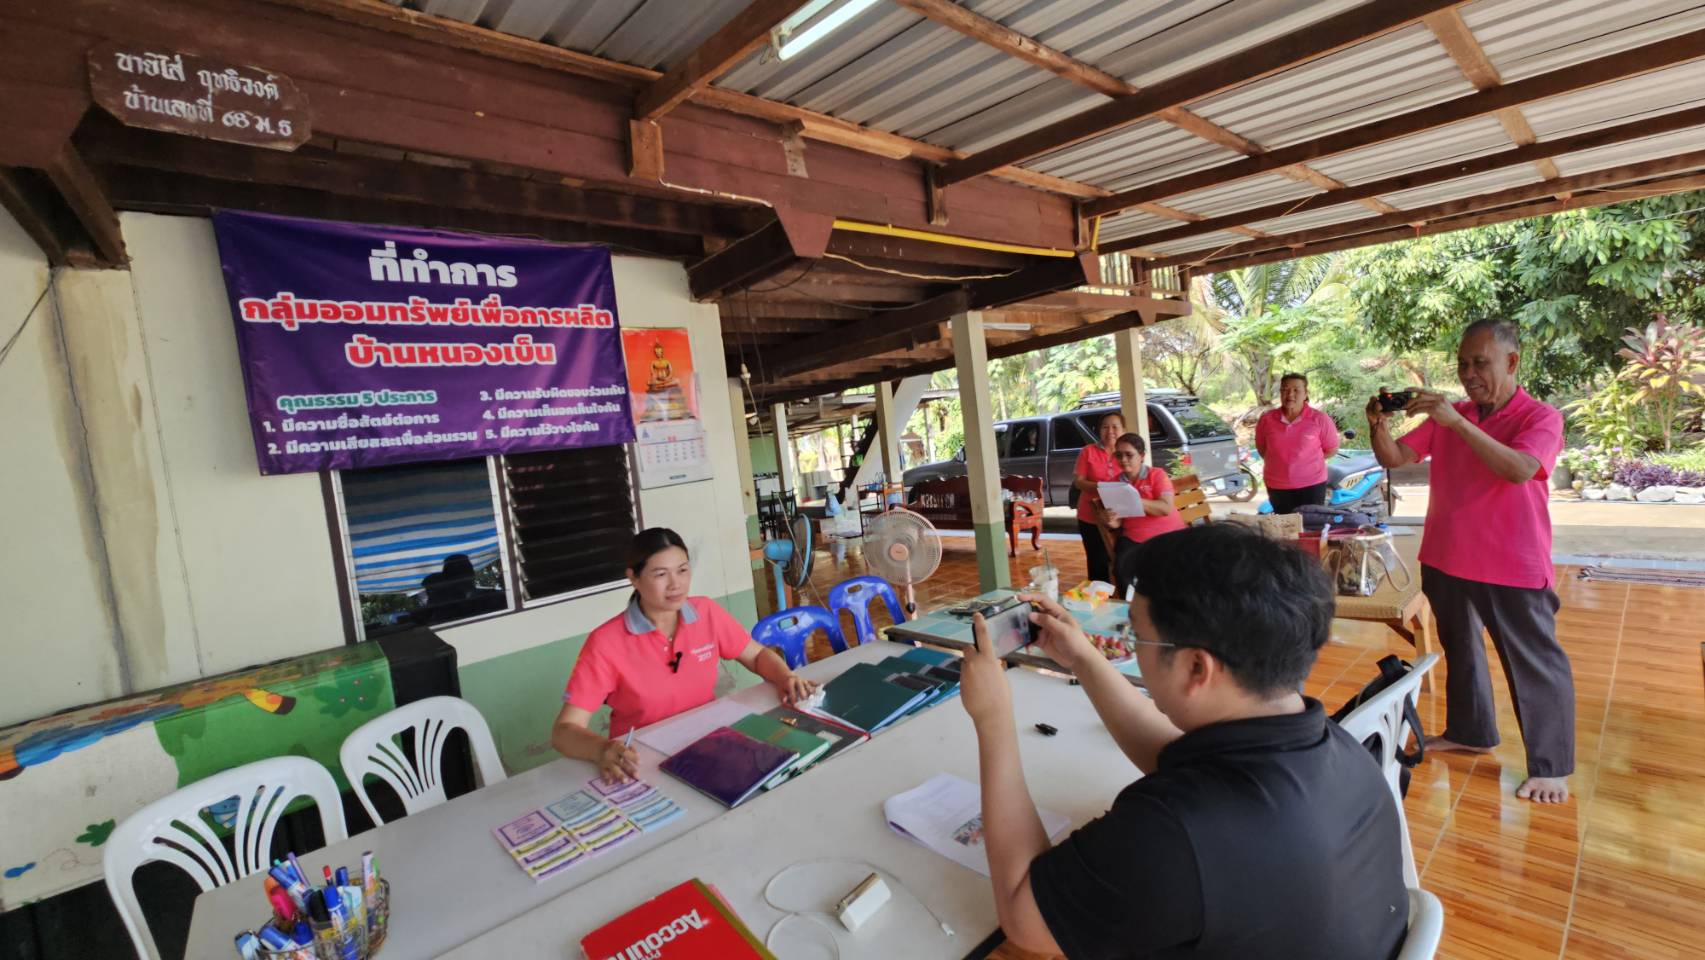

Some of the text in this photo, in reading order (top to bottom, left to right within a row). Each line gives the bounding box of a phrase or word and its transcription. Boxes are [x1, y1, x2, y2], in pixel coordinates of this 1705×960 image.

[123, 83, 214, 123] บ้านเลขที่
[222, 110, 250, 129] 68
[368, 240, 518, 288] ที่ทำการ
[239, 292, 614, 331] กลุ่มออมทรัพย์เพื่อการผลิต
[345, 334, 557, 367] บ้านหนองเบ็น
[374, 389, 437, 406] ประการ
[262, 421, 276, 433] 1.
[267, 443, 282, 455] 2.
[605, 908, 703, 960] Accoun
